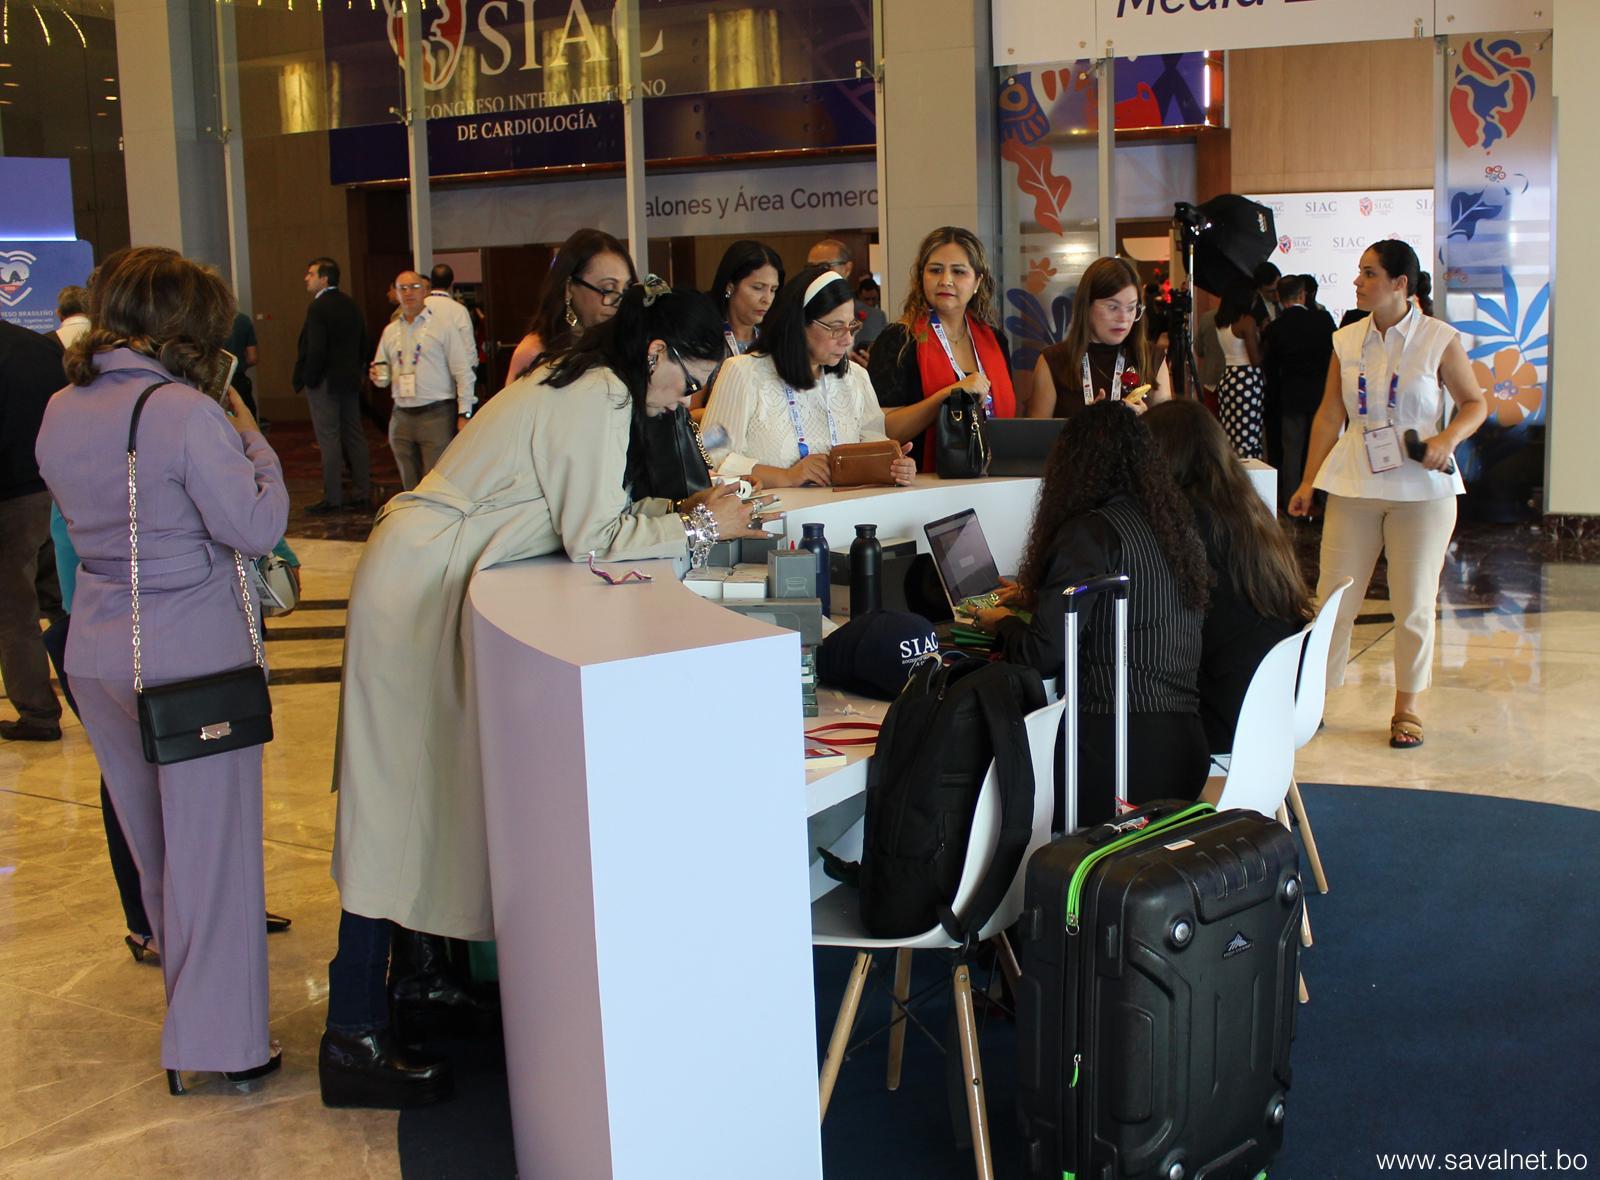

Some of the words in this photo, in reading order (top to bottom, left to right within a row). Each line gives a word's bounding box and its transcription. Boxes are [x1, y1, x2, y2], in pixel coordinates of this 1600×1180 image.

[425, 96, 505, 119] ONGRESO
[509, 79, 667, 111] INTERAMERNO
[457, 123, 477, 142] DE
[481, 109, 598, 138] CARDIOLOGÍA
[646, 196, 712, 217] alones
[717, 197, 729, 219] y
[734, 186, 785, 213] Área
[1305, 201, 1337, 213] SIAC
[1416, 199, 1433, 210] SI
[1333, 236, 1366, 249] SIAC
[899, 632, 938, 658] SIAC
